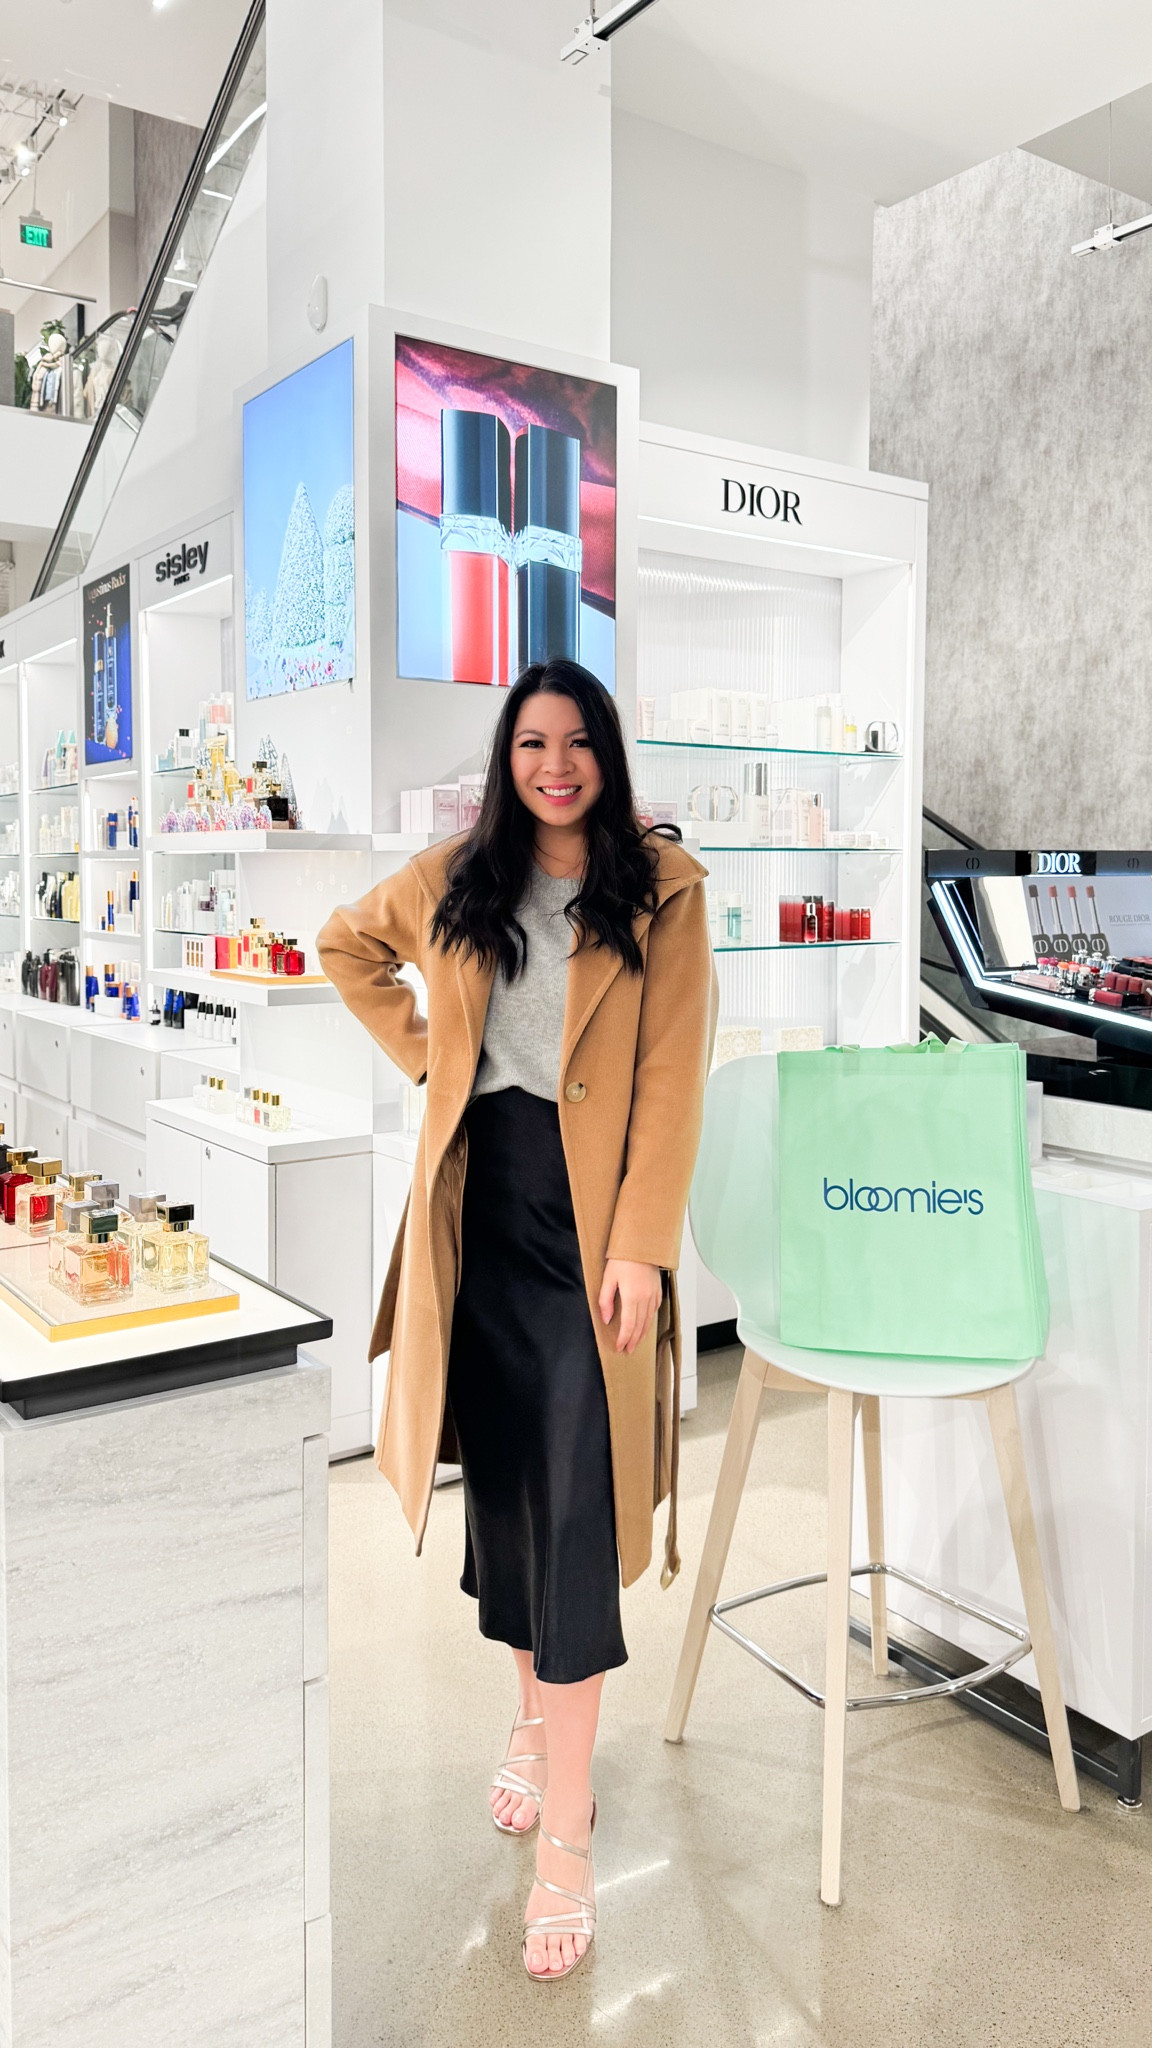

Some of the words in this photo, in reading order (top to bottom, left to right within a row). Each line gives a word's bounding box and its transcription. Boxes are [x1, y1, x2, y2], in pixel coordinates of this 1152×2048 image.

[25, 225, 49, 247] EXIT
[721, 478, 802, 525] DIOR
[155, 541, 208, 582] sisley
[1037, 852, 1082, 874] DIOR
[1109, 914, 1133, 924] ROUGE
[1133, 913, 1151, 923] DIOR
[823, 1177, 984, 1216] bloomie's
